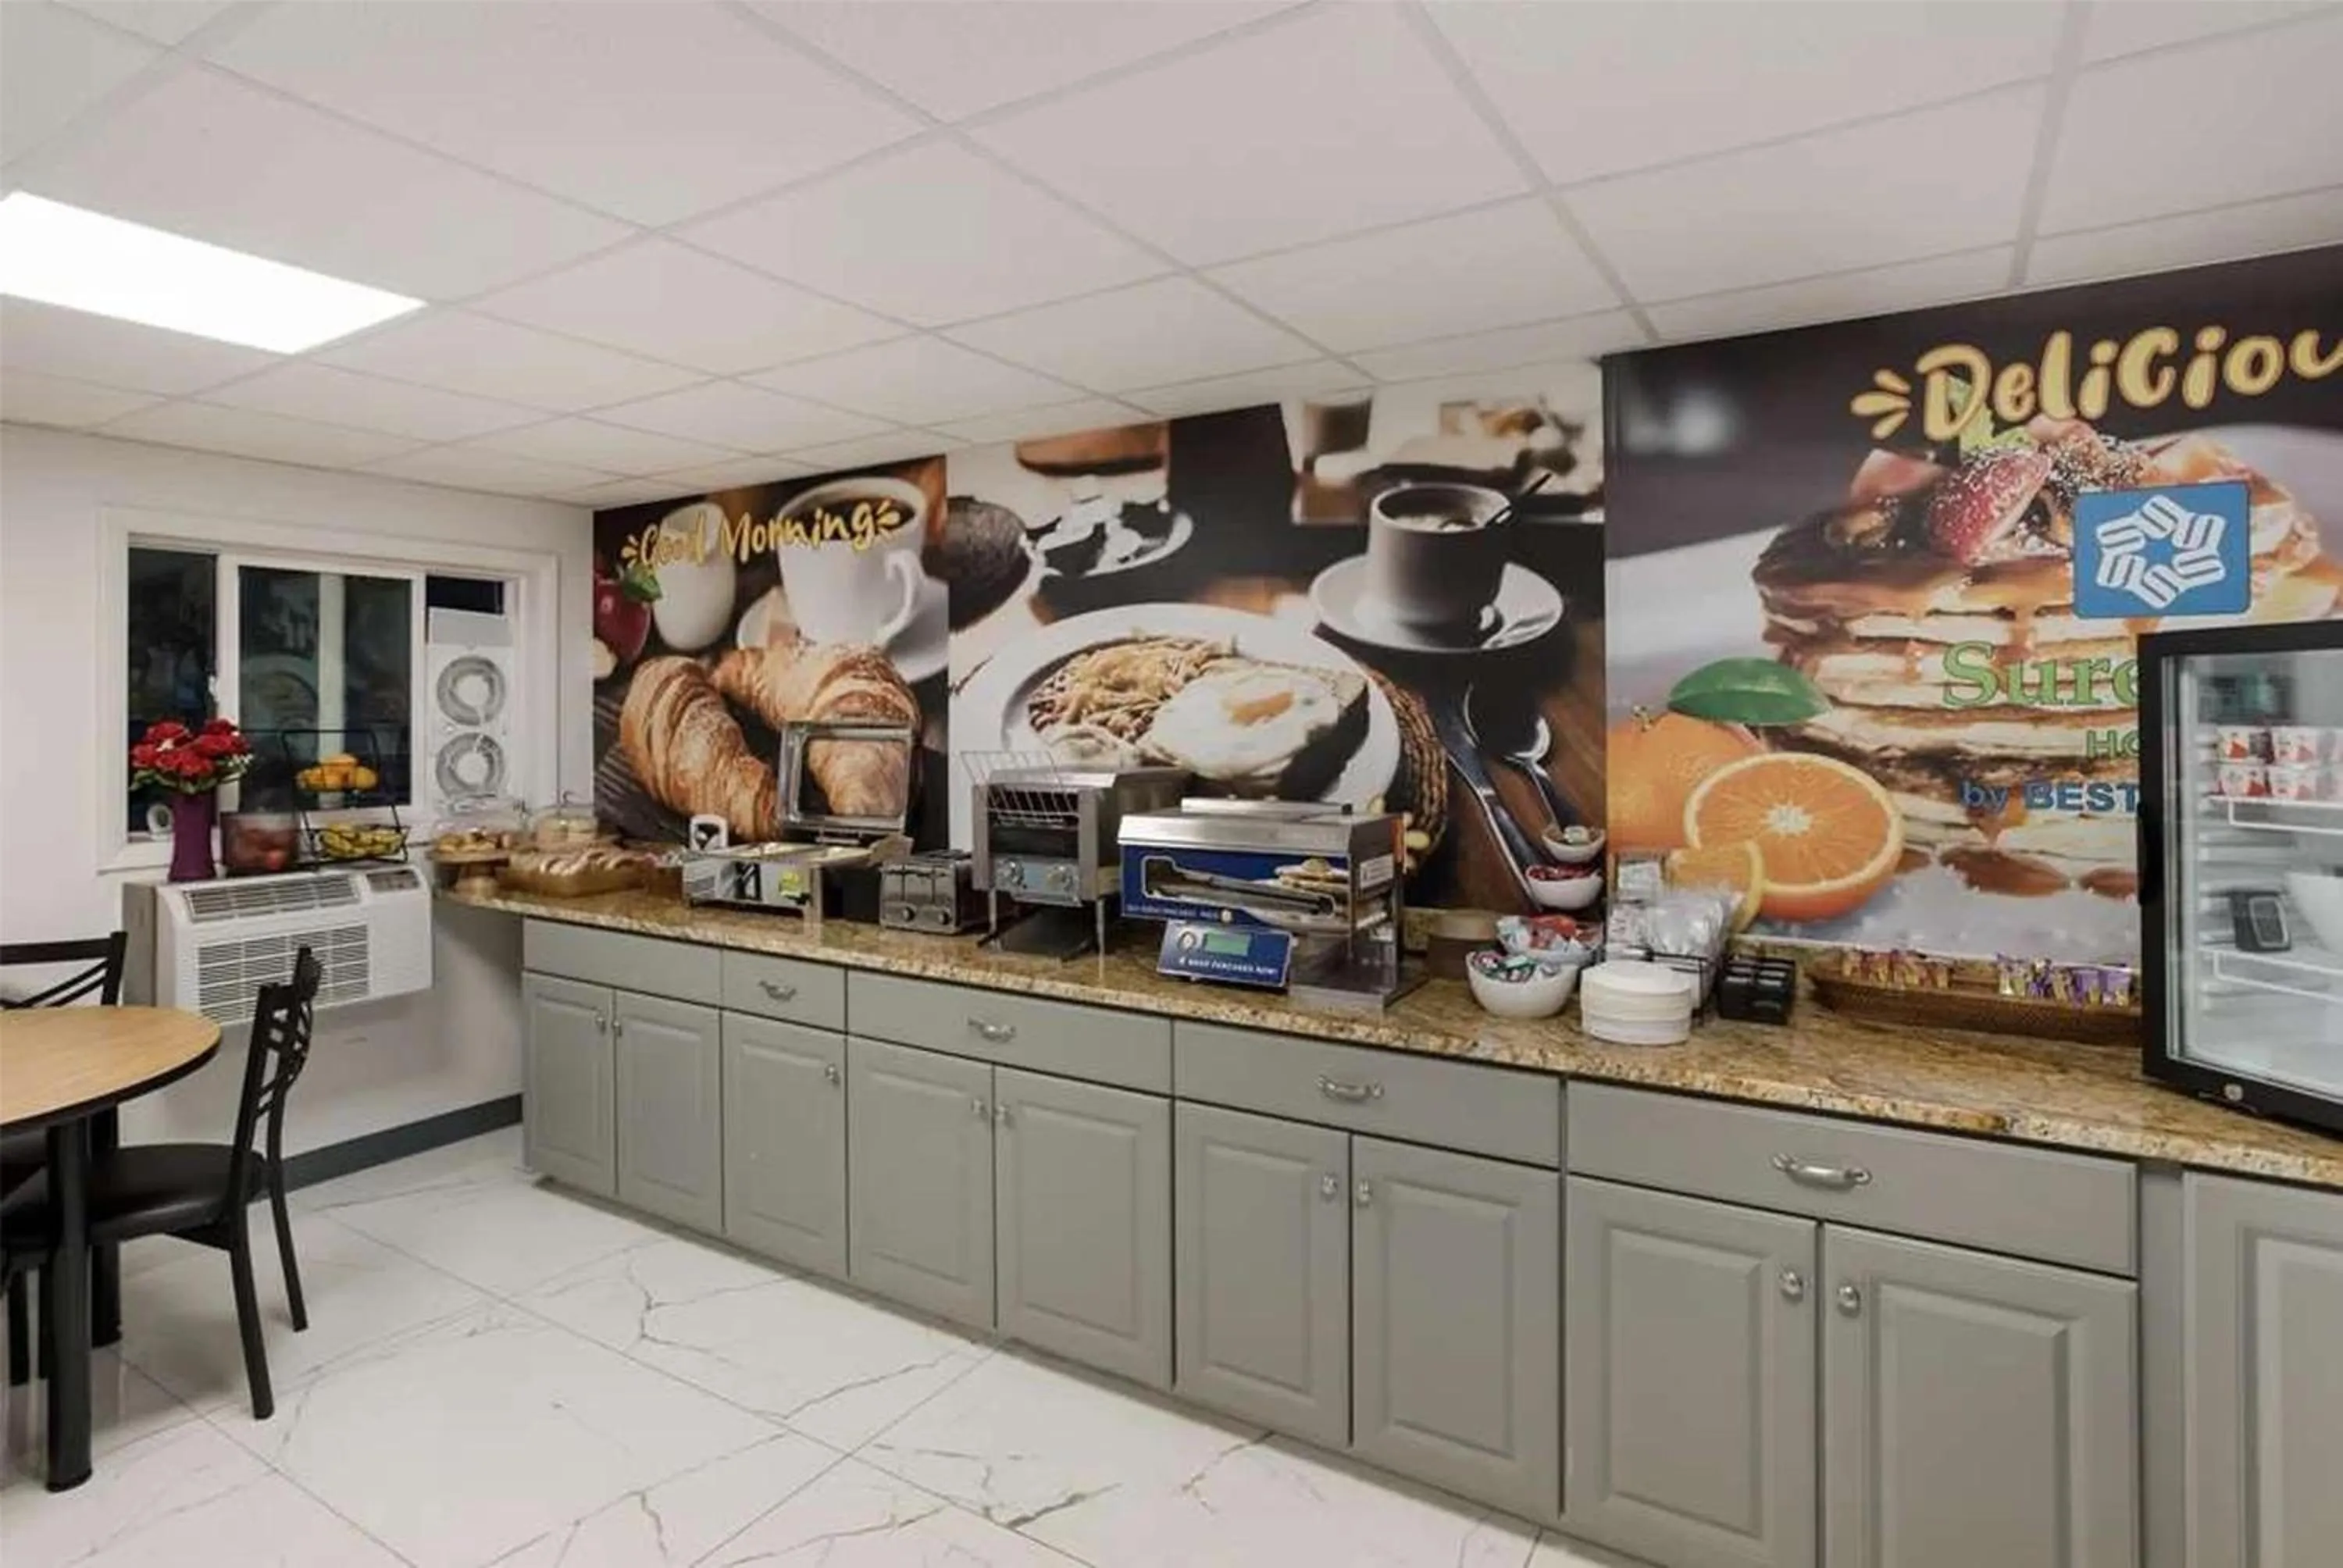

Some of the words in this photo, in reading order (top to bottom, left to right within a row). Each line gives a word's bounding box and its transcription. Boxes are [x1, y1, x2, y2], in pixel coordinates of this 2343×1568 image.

[720, 501, 875, 564] Morning
[1960, 778, 2009, 815] by
[2024, 780, 2138, 814] BEST
